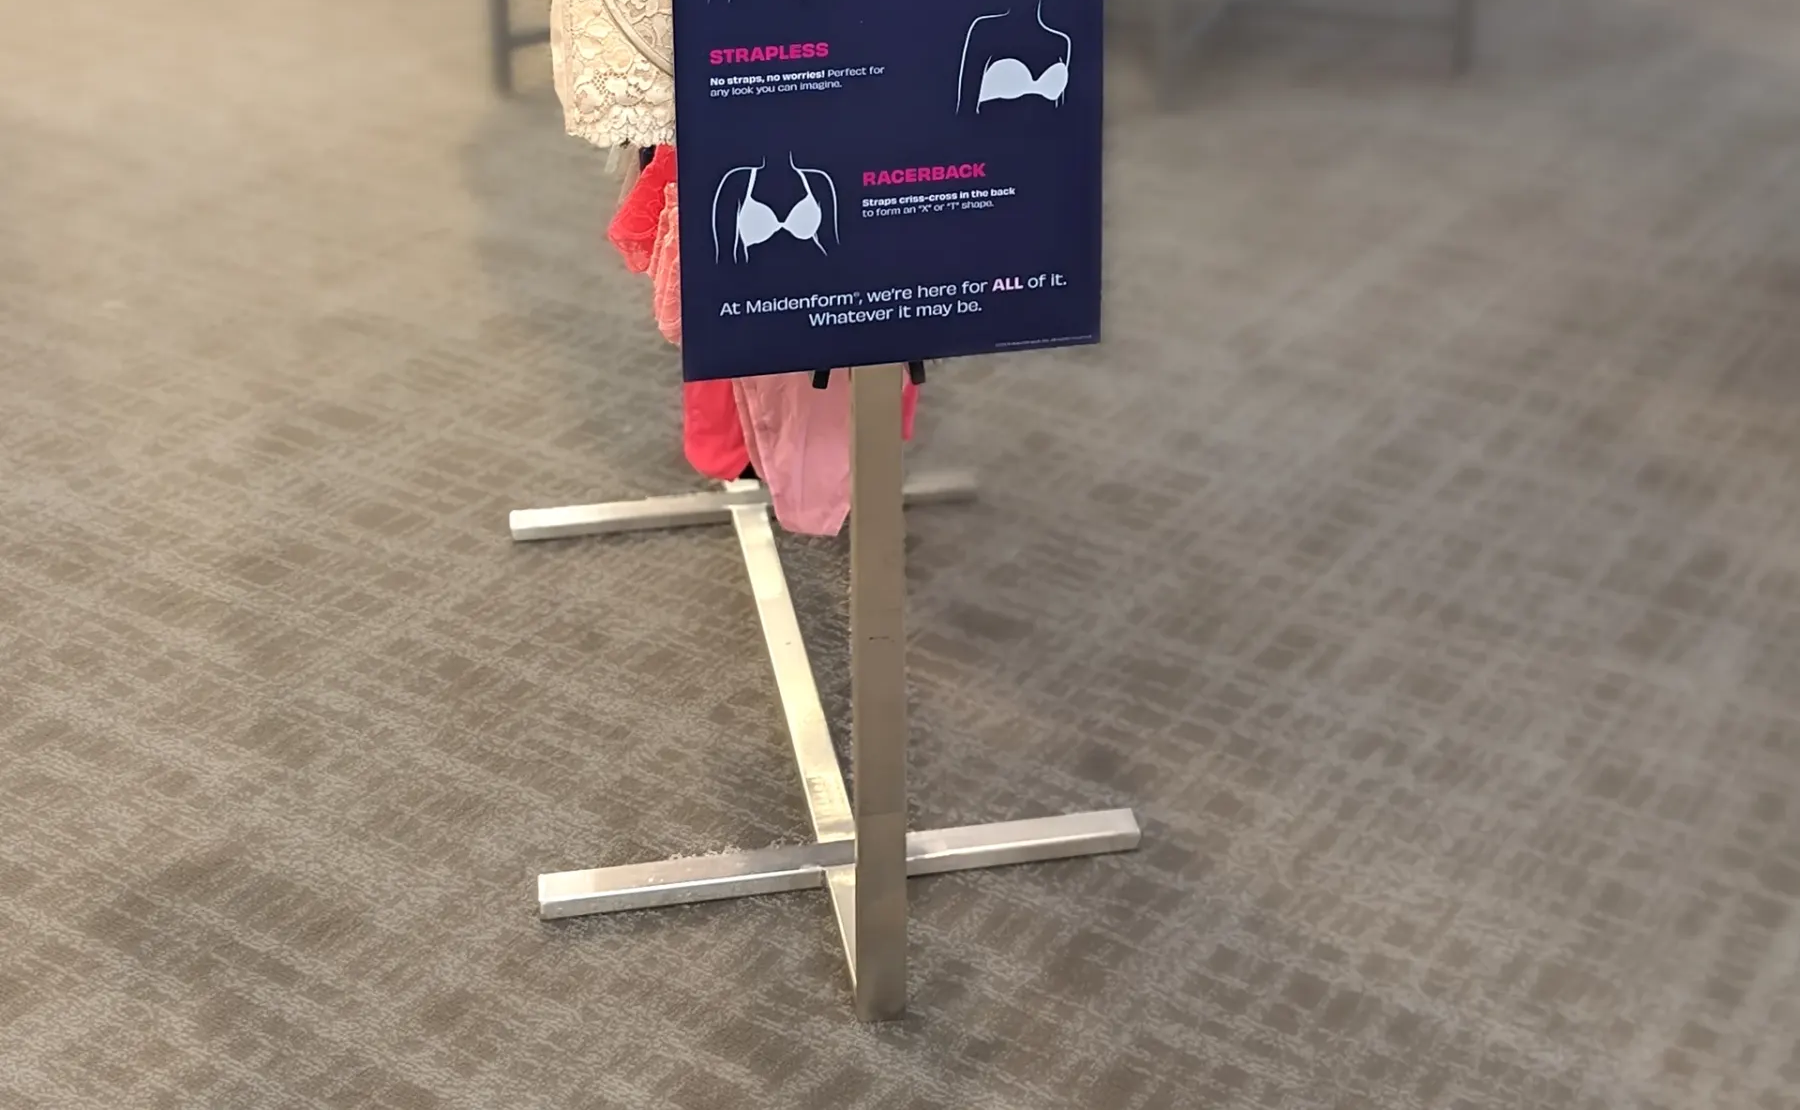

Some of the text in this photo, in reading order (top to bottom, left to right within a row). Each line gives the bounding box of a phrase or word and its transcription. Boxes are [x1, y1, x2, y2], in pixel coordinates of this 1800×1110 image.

[709, 42, 829, 65] STRAPLESS
[710, 65, 885, 86] No straps, no worries! Perfect for
[731, 86, 754, 96] look
[755, 86, 775, 95] you
[777, 83, 798, 92] can
[800, 80, 842, 91] imagine.
[862, 162, 986, 187] RACERBACK
[862, 187, 1016, 208] Straps criss-cross in the back
[862, 209, 874, 218] to
[875, 206, 901, 216] form
[903, 205, 916, 214] an
[933, 204, 945, 212] or
[961, 200, 994, 210] shape.
[719, 302, 741, 317] At
[866, 288, 913, 303] we're
[917, 283, 957, 299] here
[961, 280, 989, 295] for
[992, 277, 1024, 292] ALL
[1027, 275, 1048, 289] of
[1050, 272, 1067, 287] it.
[808, 298, 983, 327] Whatever it may be.
